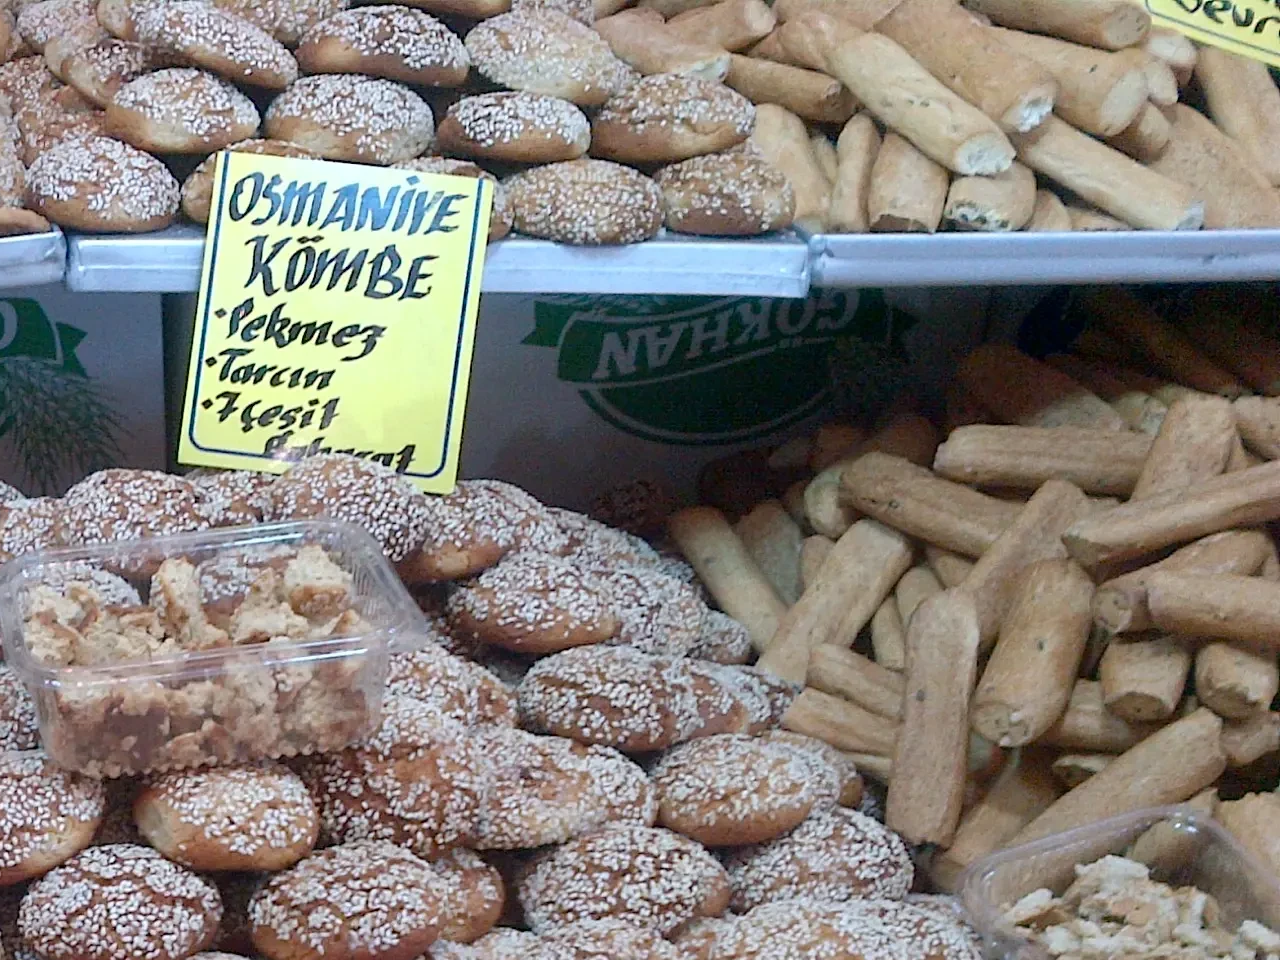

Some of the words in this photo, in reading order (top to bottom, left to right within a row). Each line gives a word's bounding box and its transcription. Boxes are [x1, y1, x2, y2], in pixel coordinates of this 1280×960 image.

[228, 171, 468, 236] OSMANİYE
[244, 235, 439, 301] KÖMBE
[227, 297, 387, 362] Pekmez
